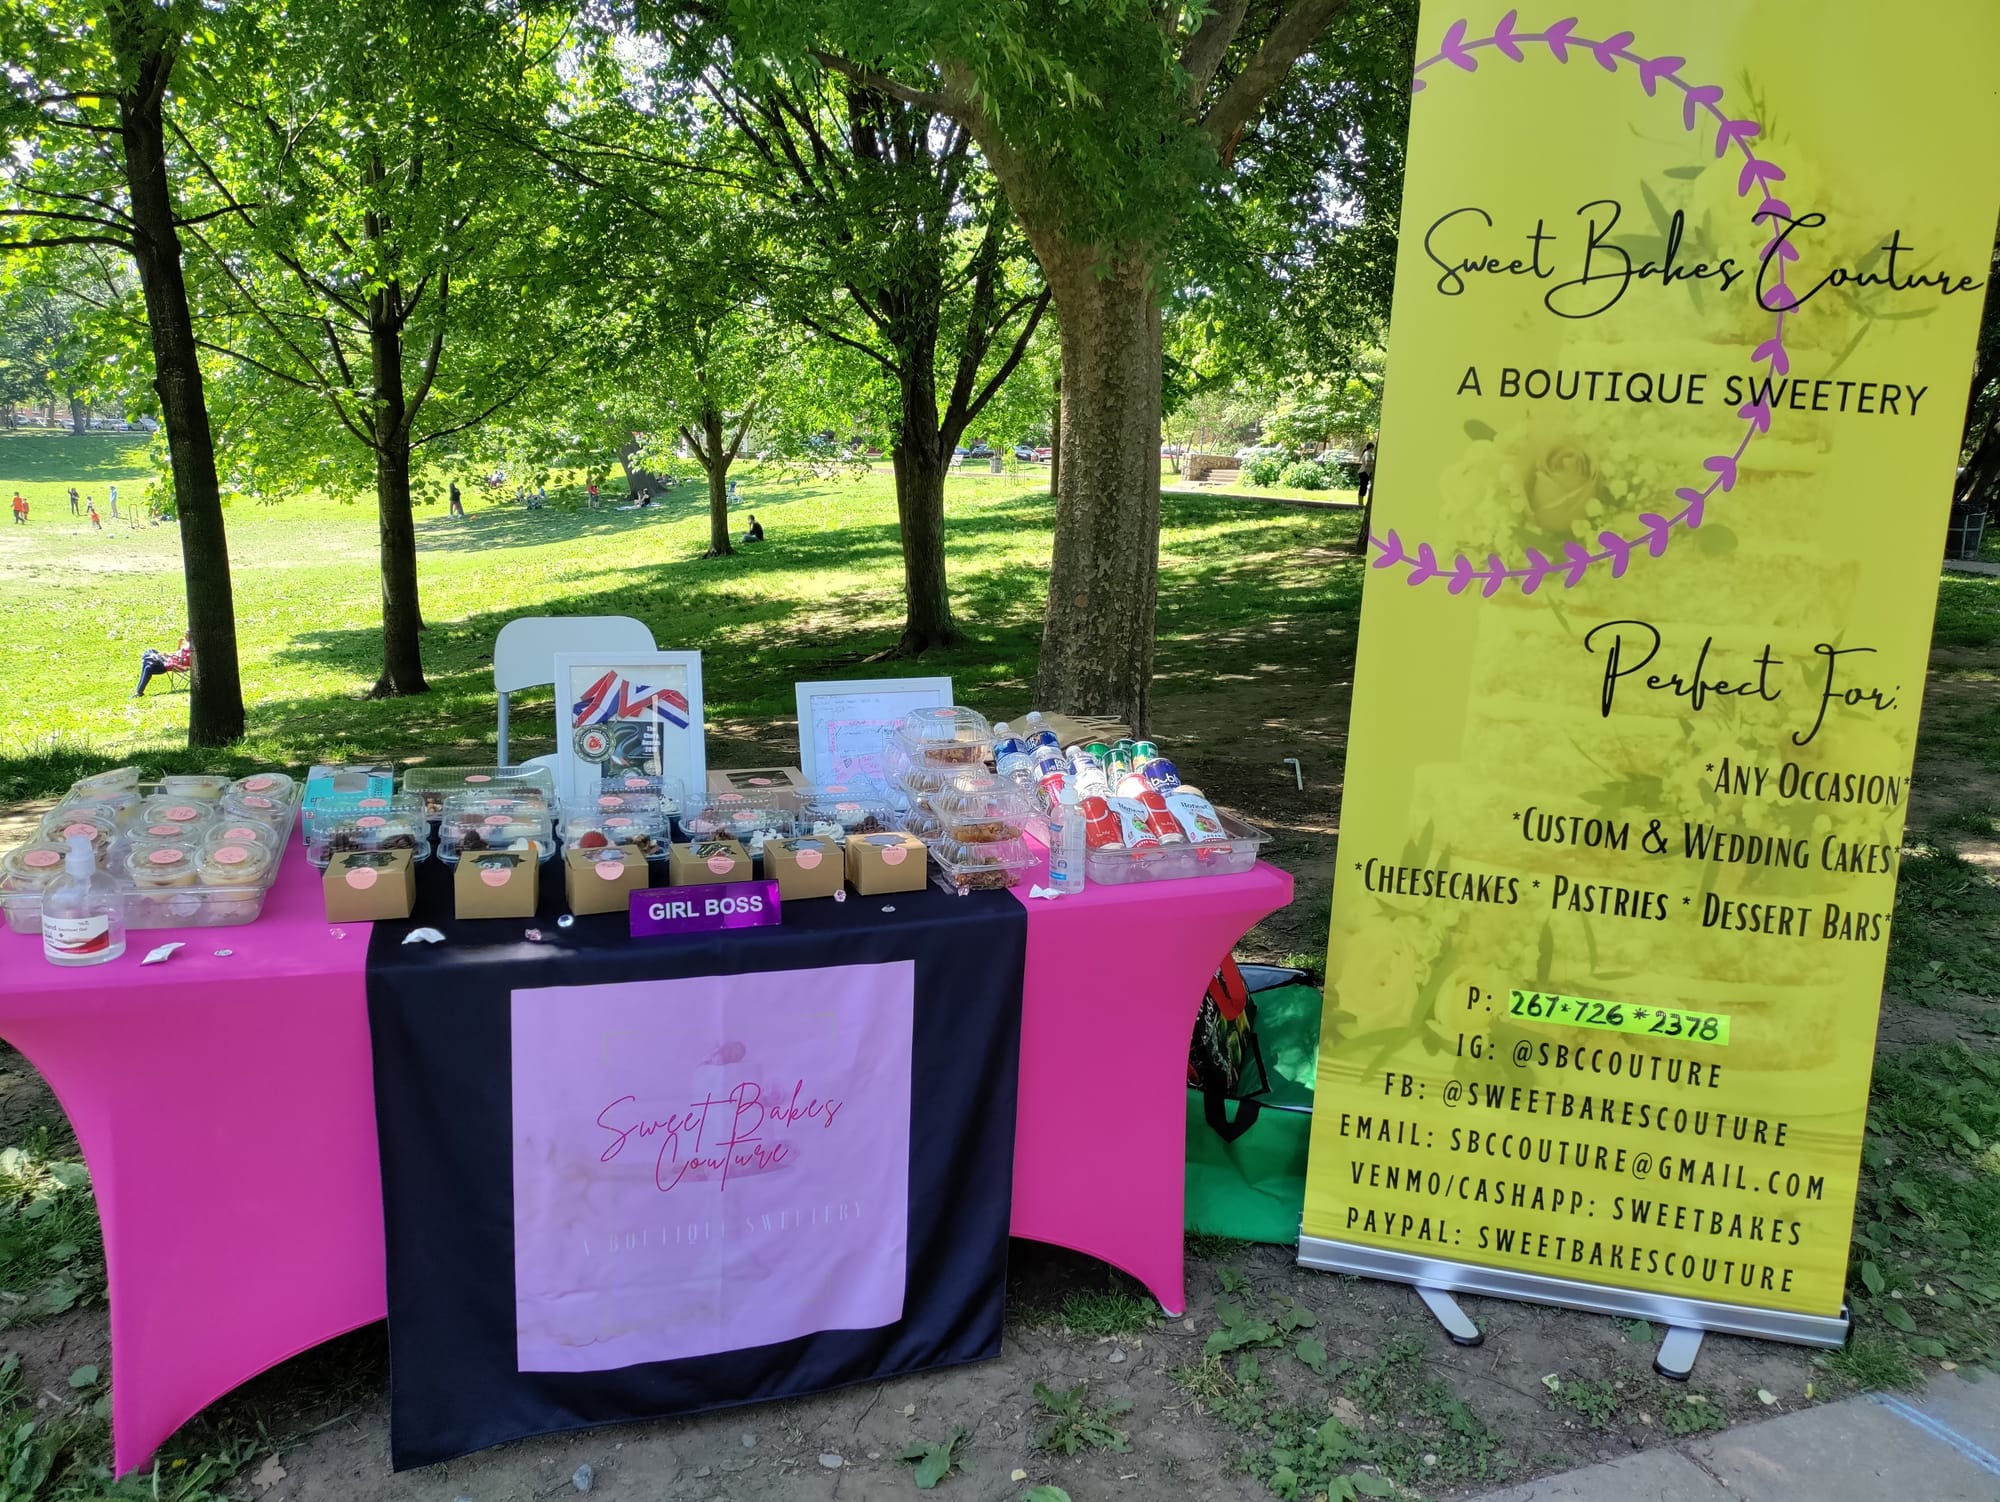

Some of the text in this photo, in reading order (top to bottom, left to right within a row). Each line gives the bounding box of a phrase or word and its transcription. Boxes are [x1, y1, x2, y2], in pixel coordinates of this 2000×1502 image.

[1424, 199, 1985, 319] Sweet Bakes Couture
[1457, 366, 1929, 416] A BOUTIQUE SWEETERY
[1583, 620, 1900, 747] Perfect For:
[1641, 818, 1669, 855] &
[648, 895, 764, 921] GIRL BOSS
[1467, 986, 1492, 1012] P:
[1456, 1033, 1721, 1089] IG: @SBCCOUTURE
[597, 1079, 843, 1162] Sweet Bakes
[1384, 1072, 1788, 1147] FB: @SWEETBAKESCOUTURE
[655, 1133, 789, 1192] Couture
[1339, 1113, 1825, 1201] EMAIL: SBCCOUTURE@GMAIL.COM
[1350, 1161, 1801, 1246] VENMO/CASHAPP: SWEETBAKES
[1346, 1206, 1794, 1293] PAYPAL: SWEETBAKESCOUTURE
